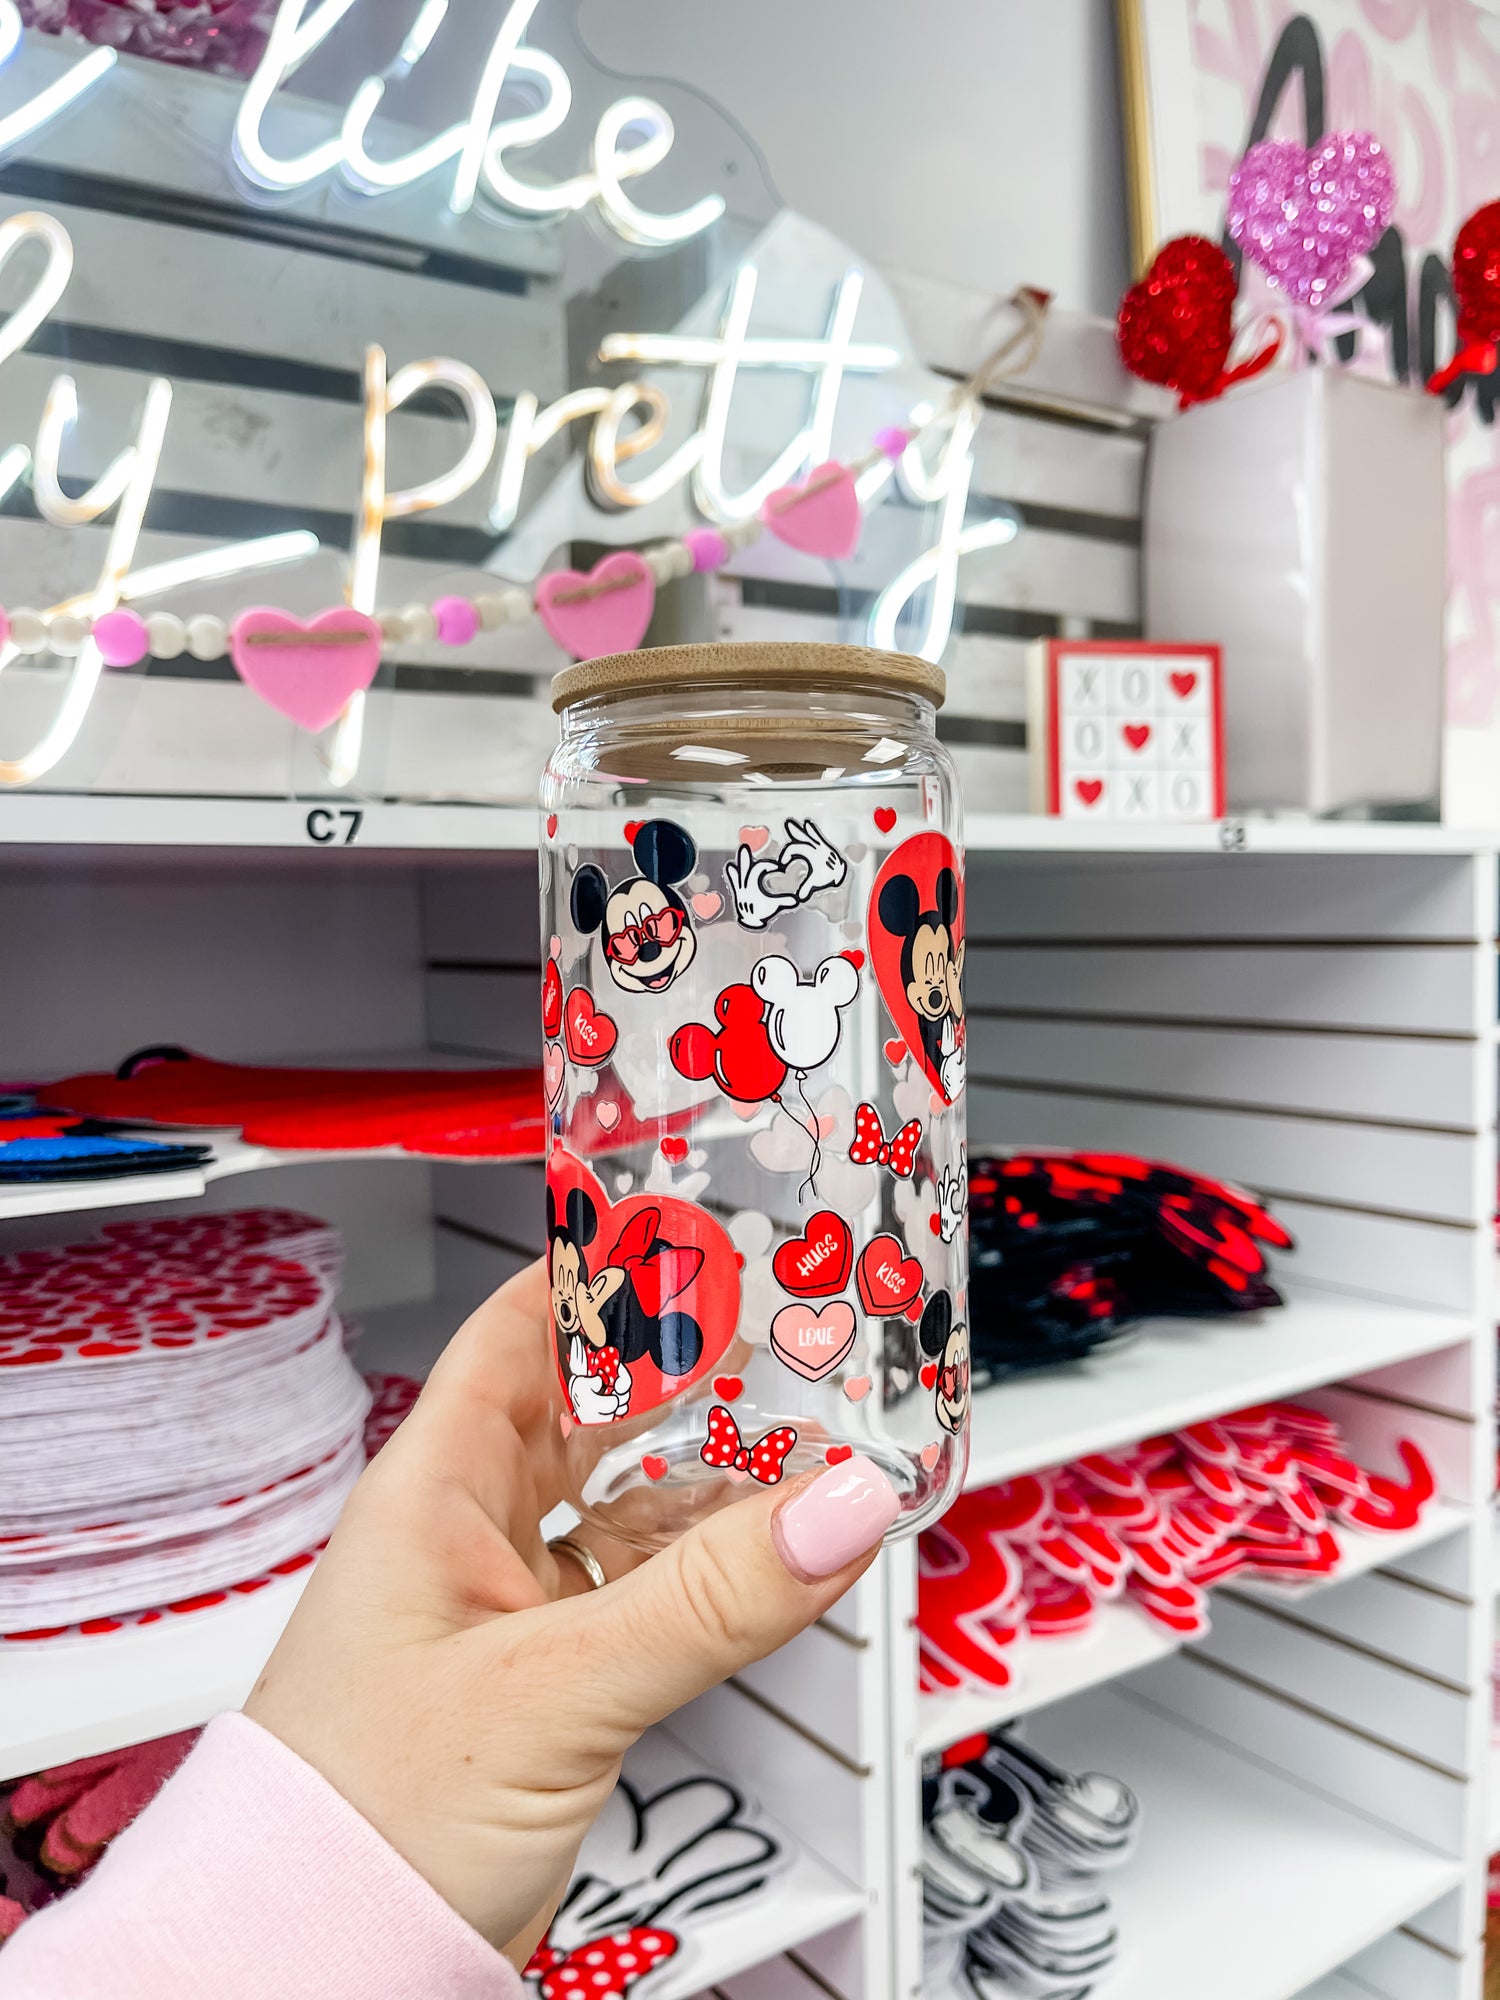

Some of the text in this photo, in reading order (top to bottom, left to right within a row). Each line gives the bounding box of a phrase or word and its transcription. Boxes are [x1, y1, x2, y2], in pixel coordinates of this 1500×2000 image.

[232, 0, 727, 246] like
[328, 262, 1017, 787] pretty
[306, 808, 364, 845] C7
[574, 1013, 599, 1047] KISS
[795, 1233, 839, 1278] HUGS
[874, 1260, 906, 1295] KISS
[797, 1325, 837, 1348] LOVE
